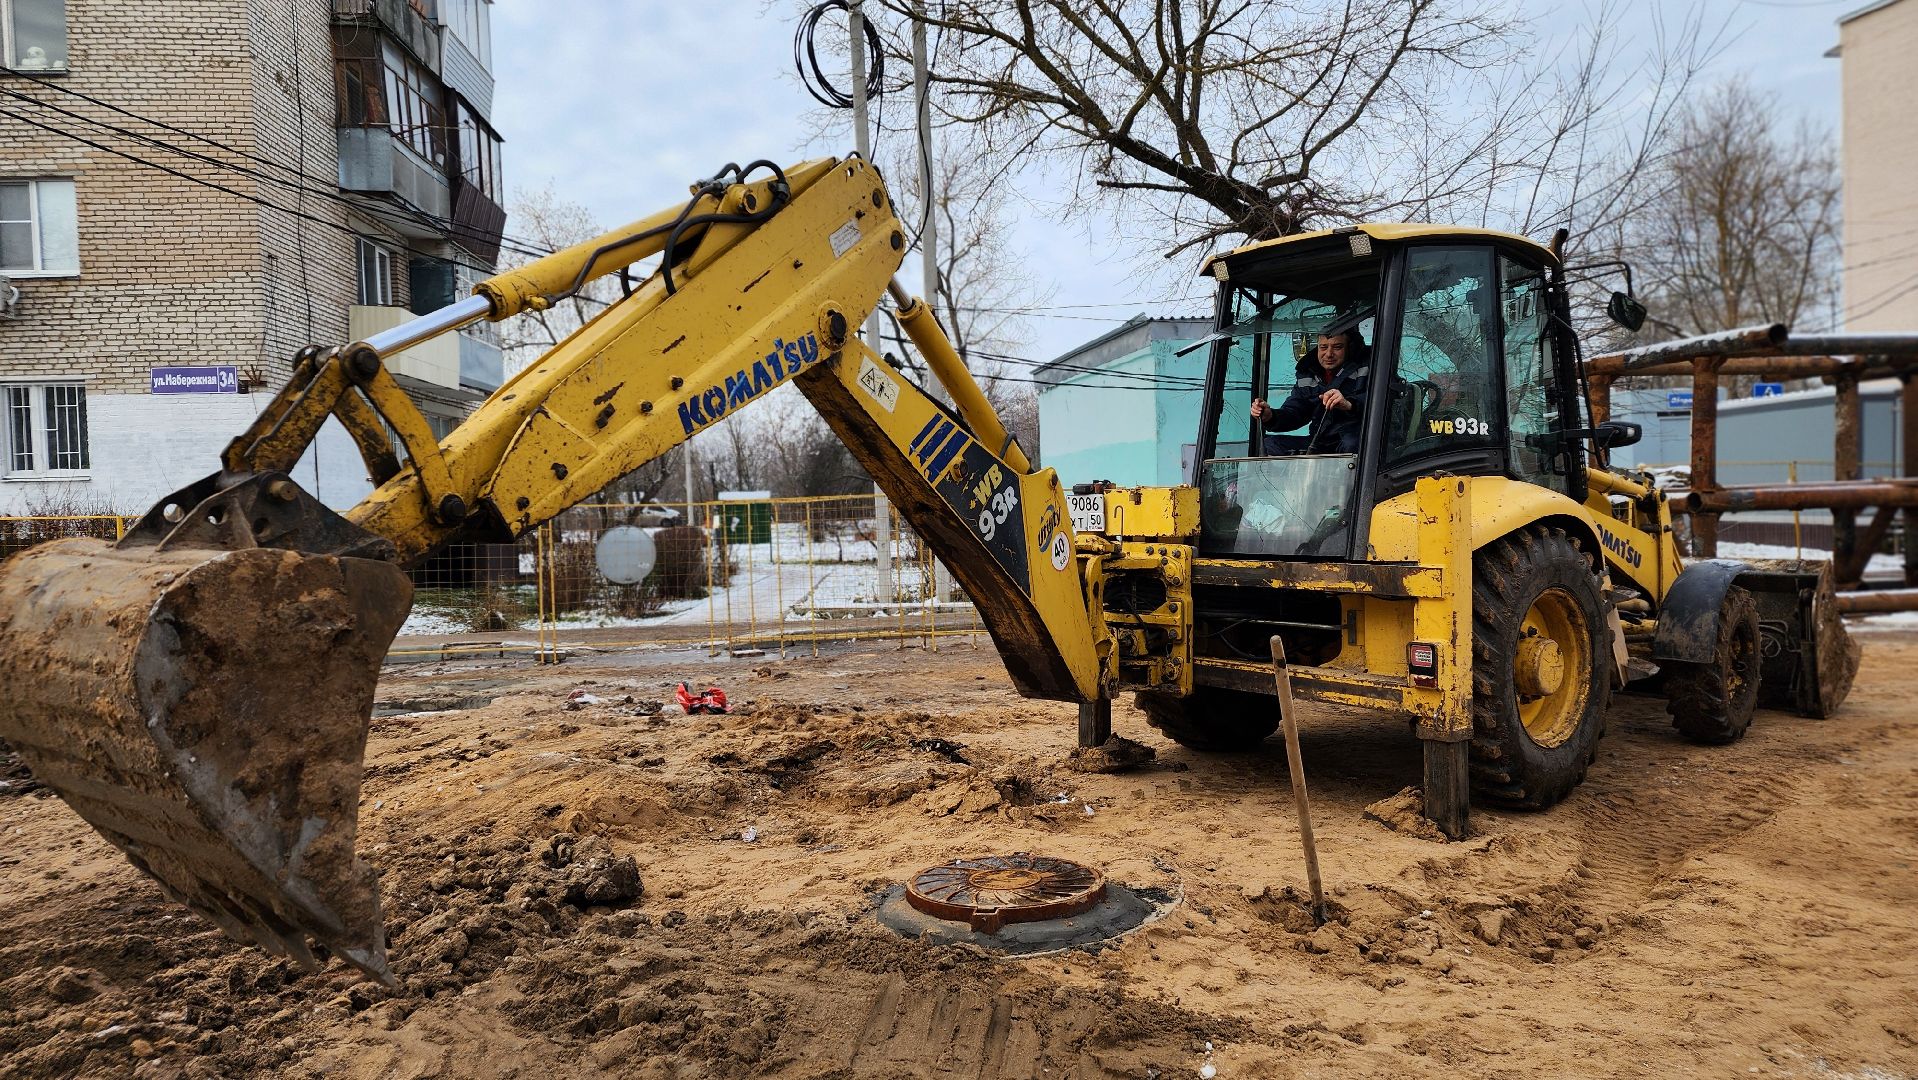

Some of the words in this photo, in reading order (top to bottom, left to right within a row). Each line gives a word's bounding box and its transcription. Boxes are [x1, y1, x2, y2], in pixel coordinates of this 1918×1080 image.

[219, 370, 235, 388] 3А
[677, 334, 819, 435] KOMATSU
[973, 463, 1003, 506] WB
[978, 486, 1019, 542] 93R
[1072, 496, 1100, 512] 9086
[1090, 514, 1102, 526] 50
[1055, 538, 1065, 558] 40
[1595, 523, 1642, 569] OMATSU
